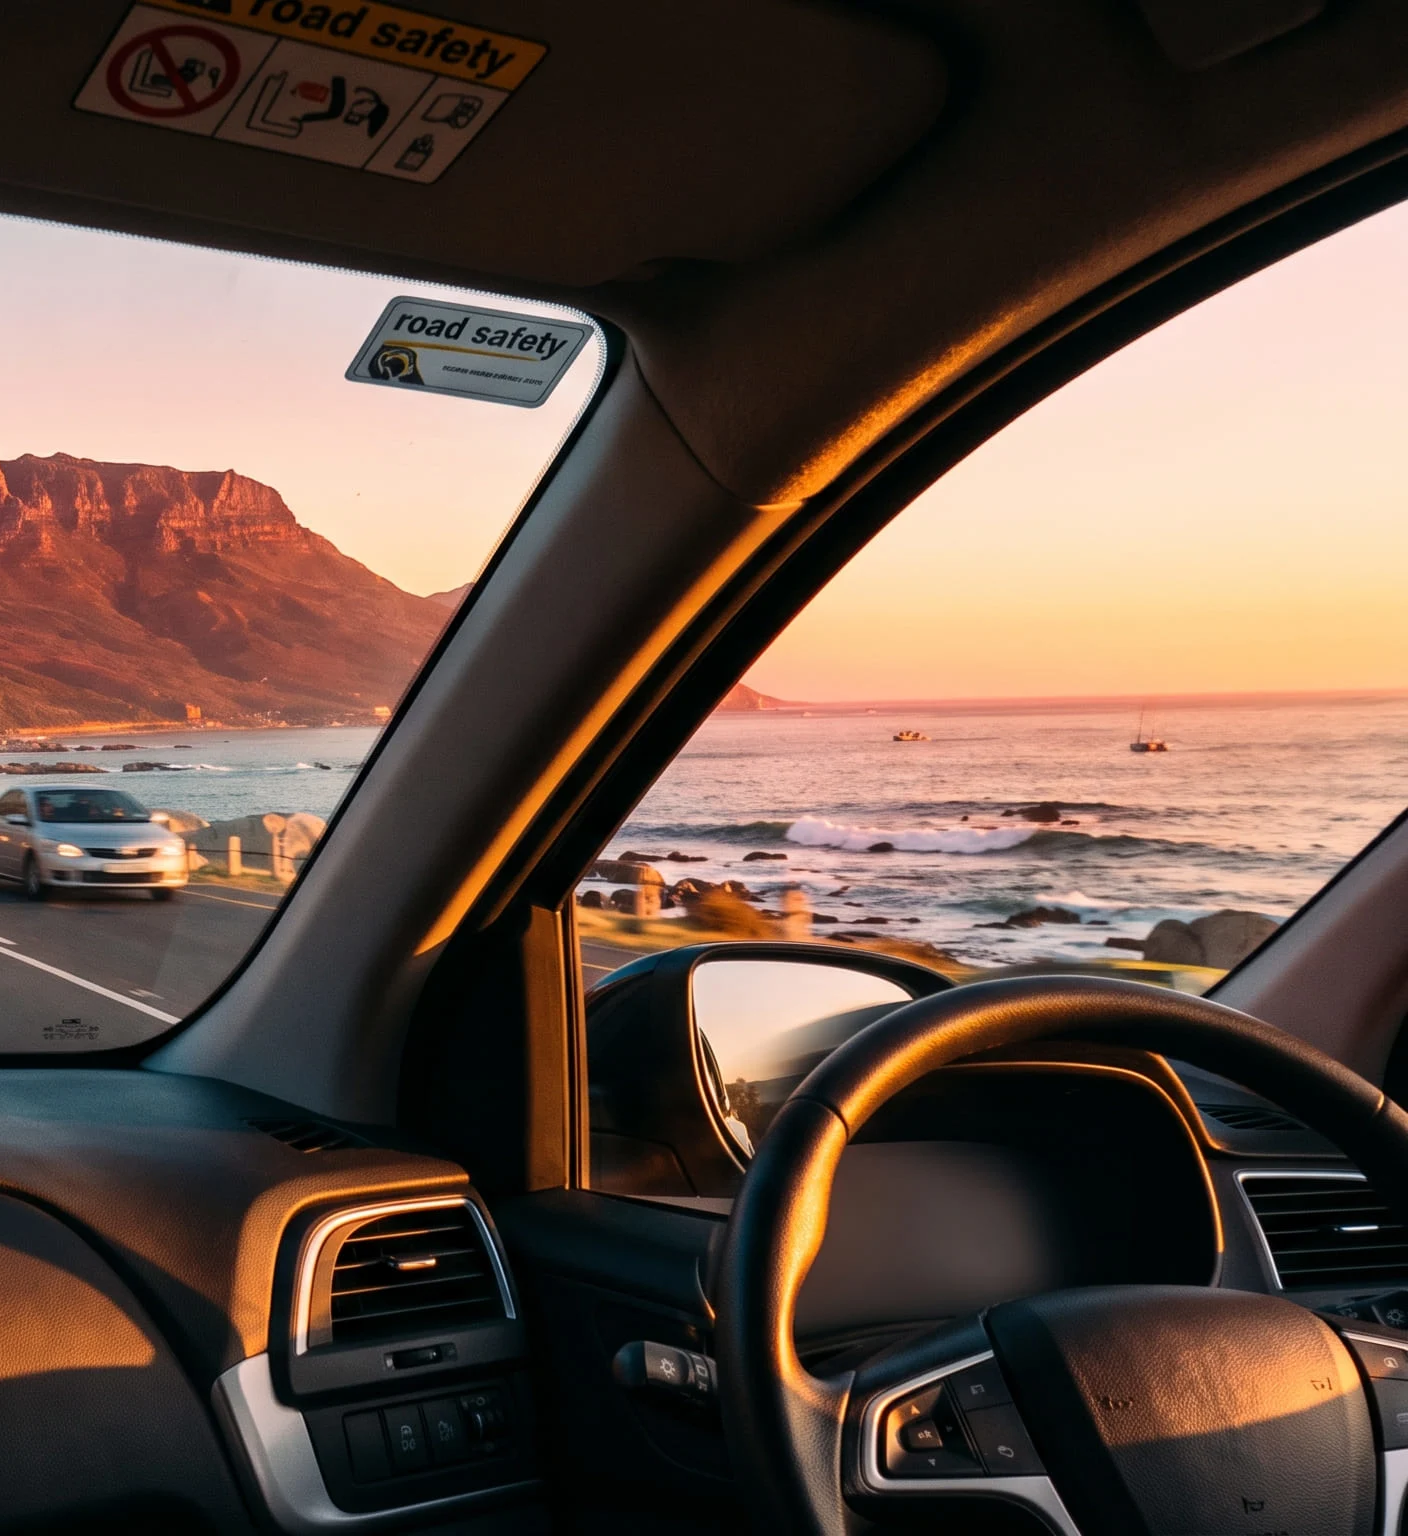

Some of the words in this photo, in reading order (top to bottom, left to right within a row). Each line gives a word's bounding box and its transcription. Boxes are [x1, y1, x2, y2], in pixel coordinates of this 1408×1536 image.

[370, 20, 514, 79] safety
[393, 313, 470, 341] road
[471, 326, 568, 361] safety
